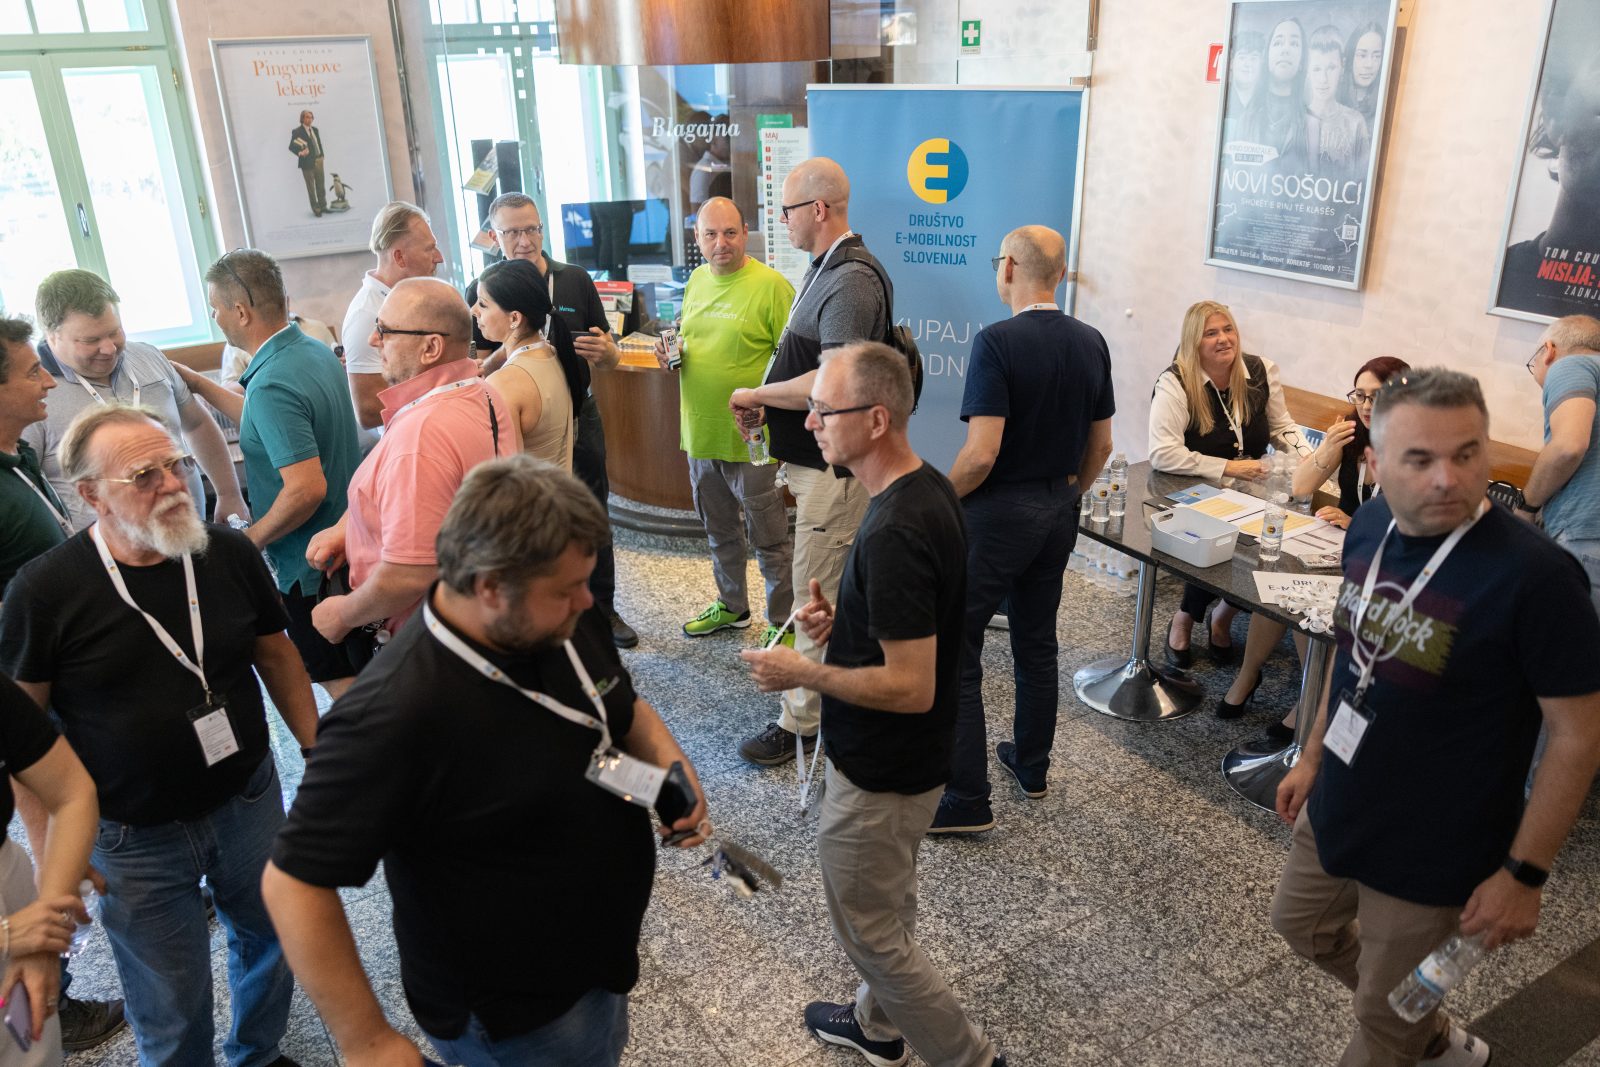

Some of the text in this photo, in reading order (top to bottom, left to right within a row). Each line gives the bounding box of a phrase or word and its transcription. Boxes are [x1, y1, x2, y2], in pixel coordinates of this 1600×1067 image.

[253, 60, 341, 80] Pingvinove
[276, 80, 326, 98] lekcije
[652, 117, 740, 143] Blagajna
[1223, 169, 1362, 205] NOVI SOŠOLCI
[908, 212, 964, 228] DRUŠTVO
[895, 232, 977, 248] E-MOBILNOST
[903, 250, 968, 266] SLOVENIJA
[1544, 246, 1569, 260] TOM
[1536, 259, 1596, 287] MISIJA:
[1339, 582, 1388, 622] Had
